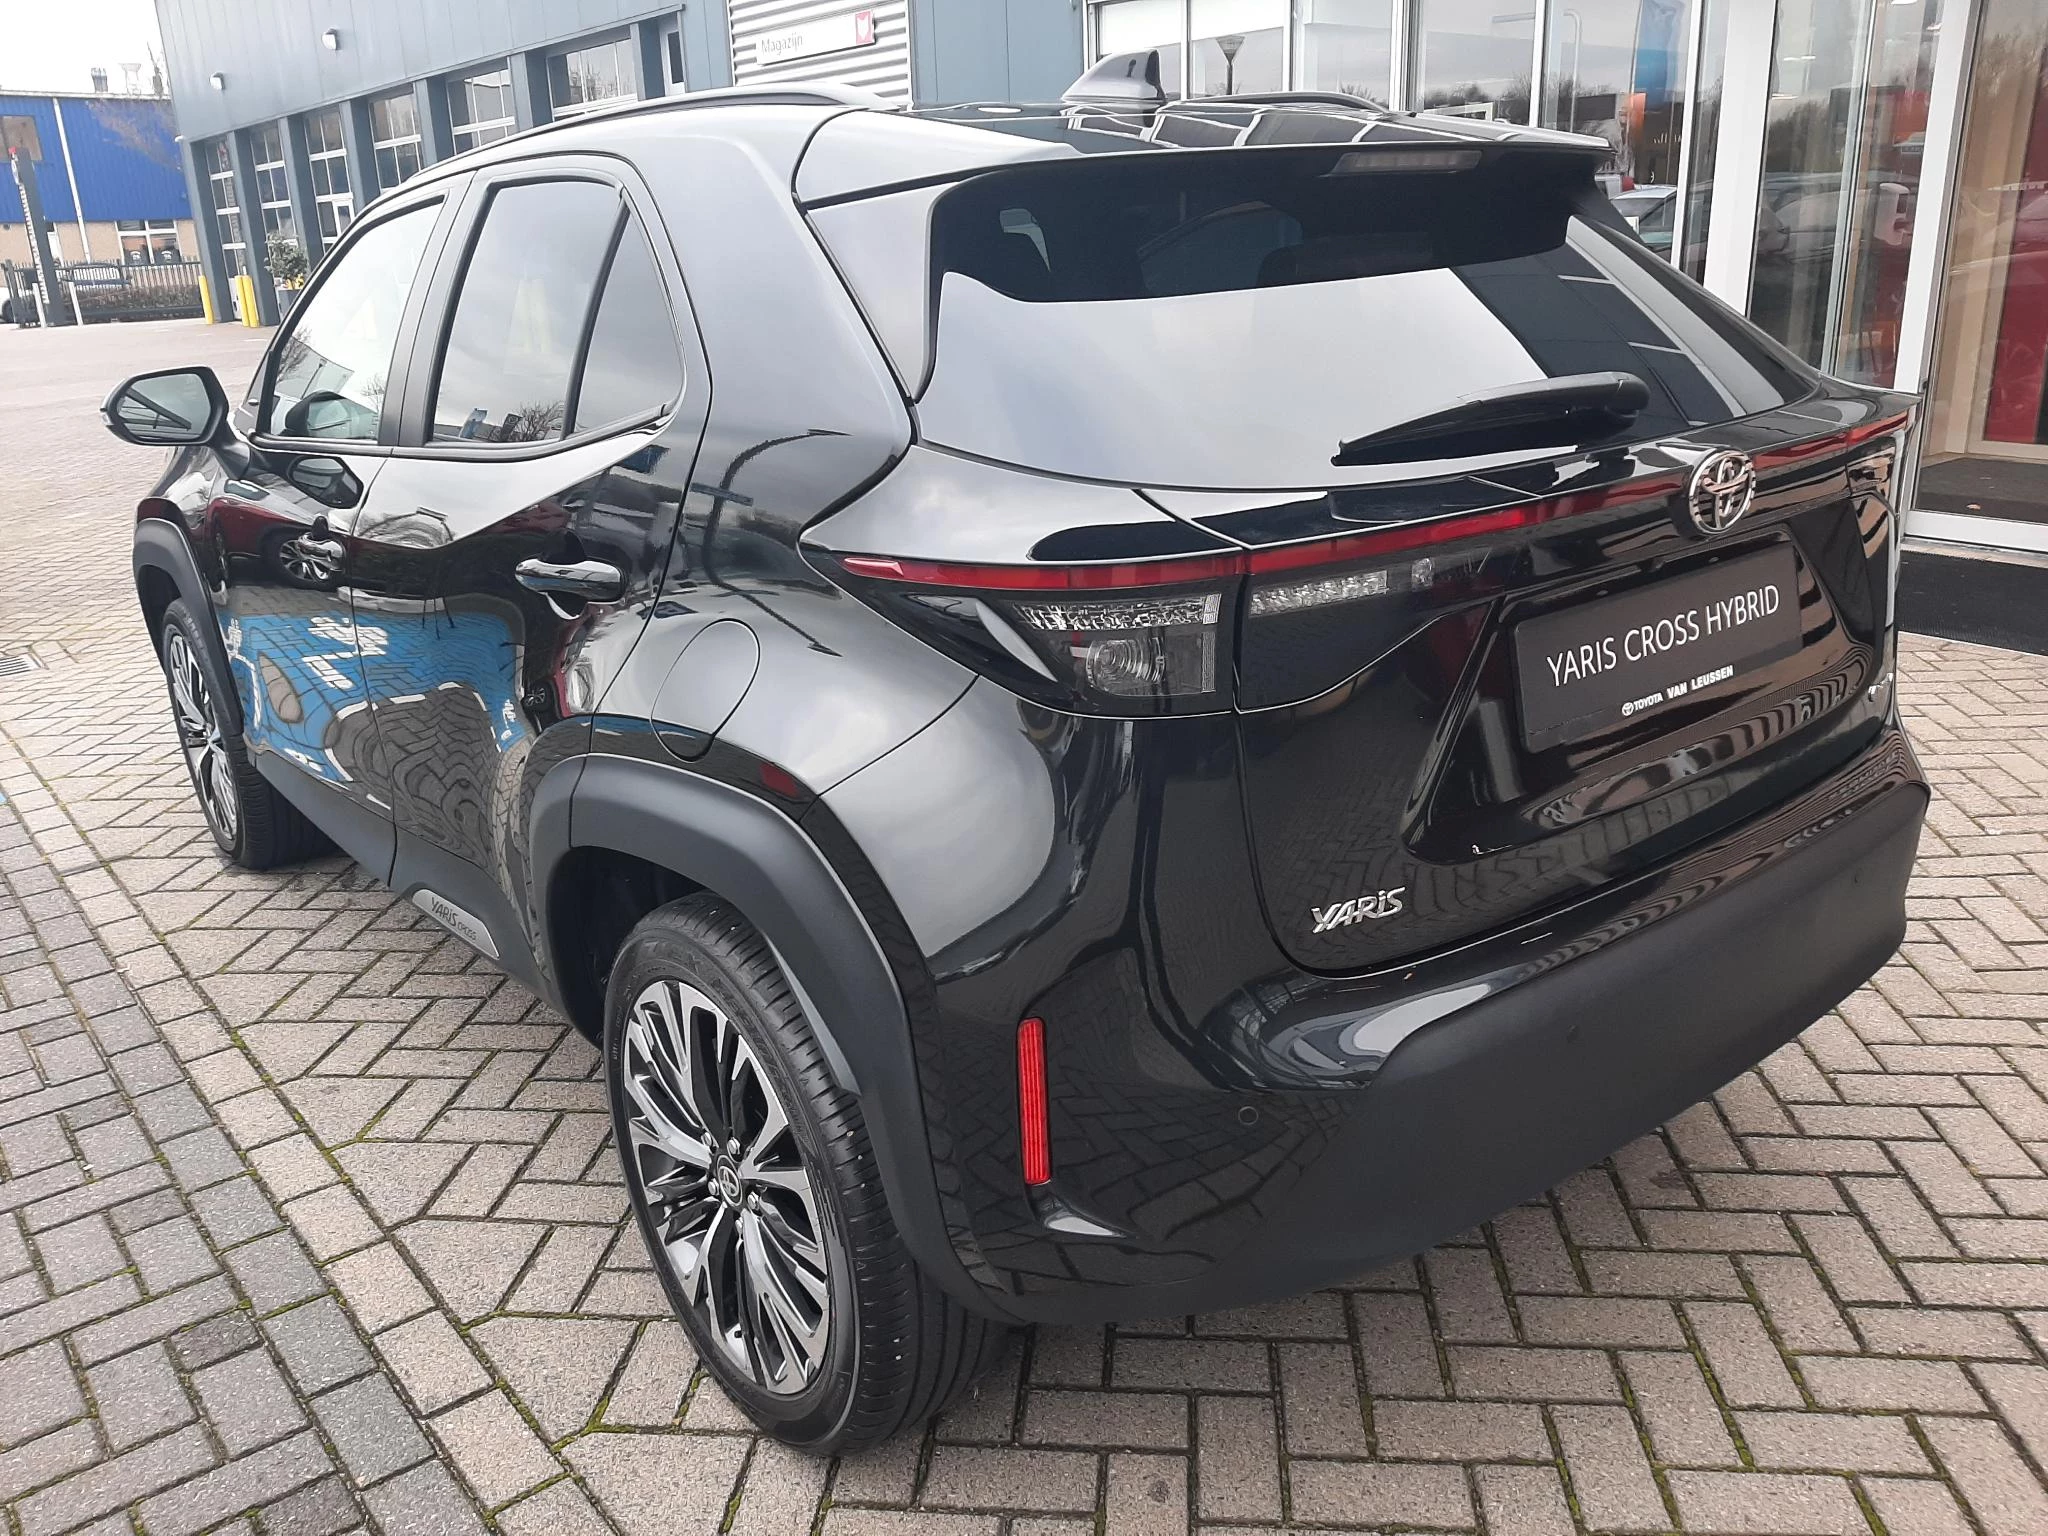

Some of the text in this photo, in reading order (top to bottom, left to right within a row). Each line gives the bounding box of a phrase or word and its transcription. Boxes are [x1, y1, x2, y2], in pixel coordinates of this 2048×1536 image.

[761, 32, 803, 56] Magazijn
[1546, 584, 1780, 687] YARIS CROSS HYBRID
[1633, 664, 1734, 711] TOYOTA VAN LEUSSEN
